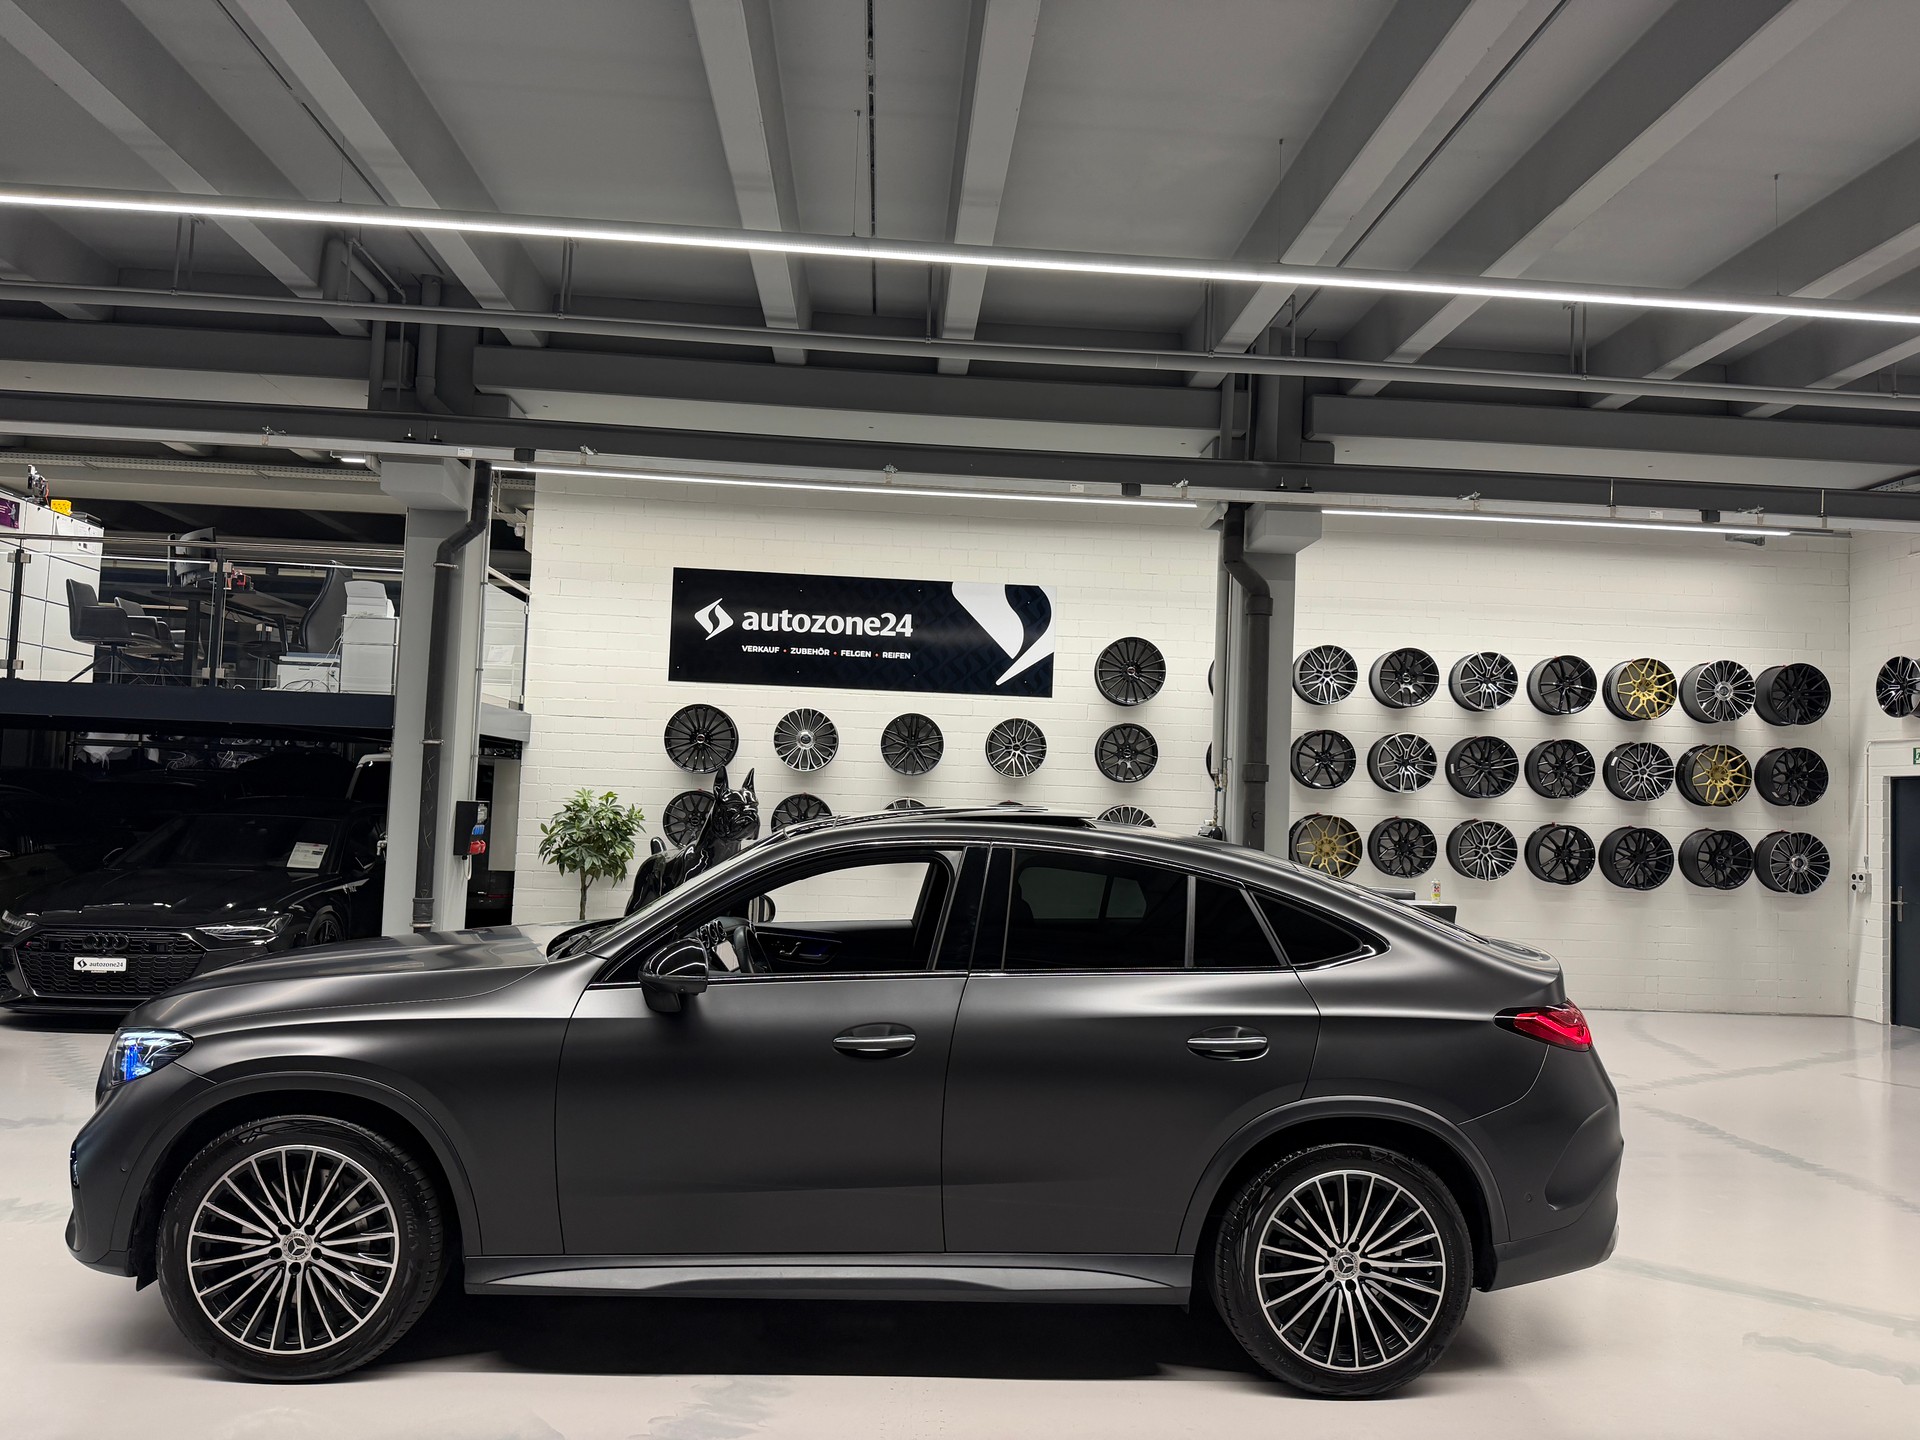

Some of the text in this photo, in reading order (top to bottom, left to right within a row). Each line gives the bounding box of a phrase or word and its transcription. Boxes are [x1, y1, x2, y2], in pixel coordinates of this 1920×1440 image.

[741, 609, 914, 638] autozone24
[741, 645, 911, 660] VERKAUF ZUBEHÖR FELGEN REIFEN
